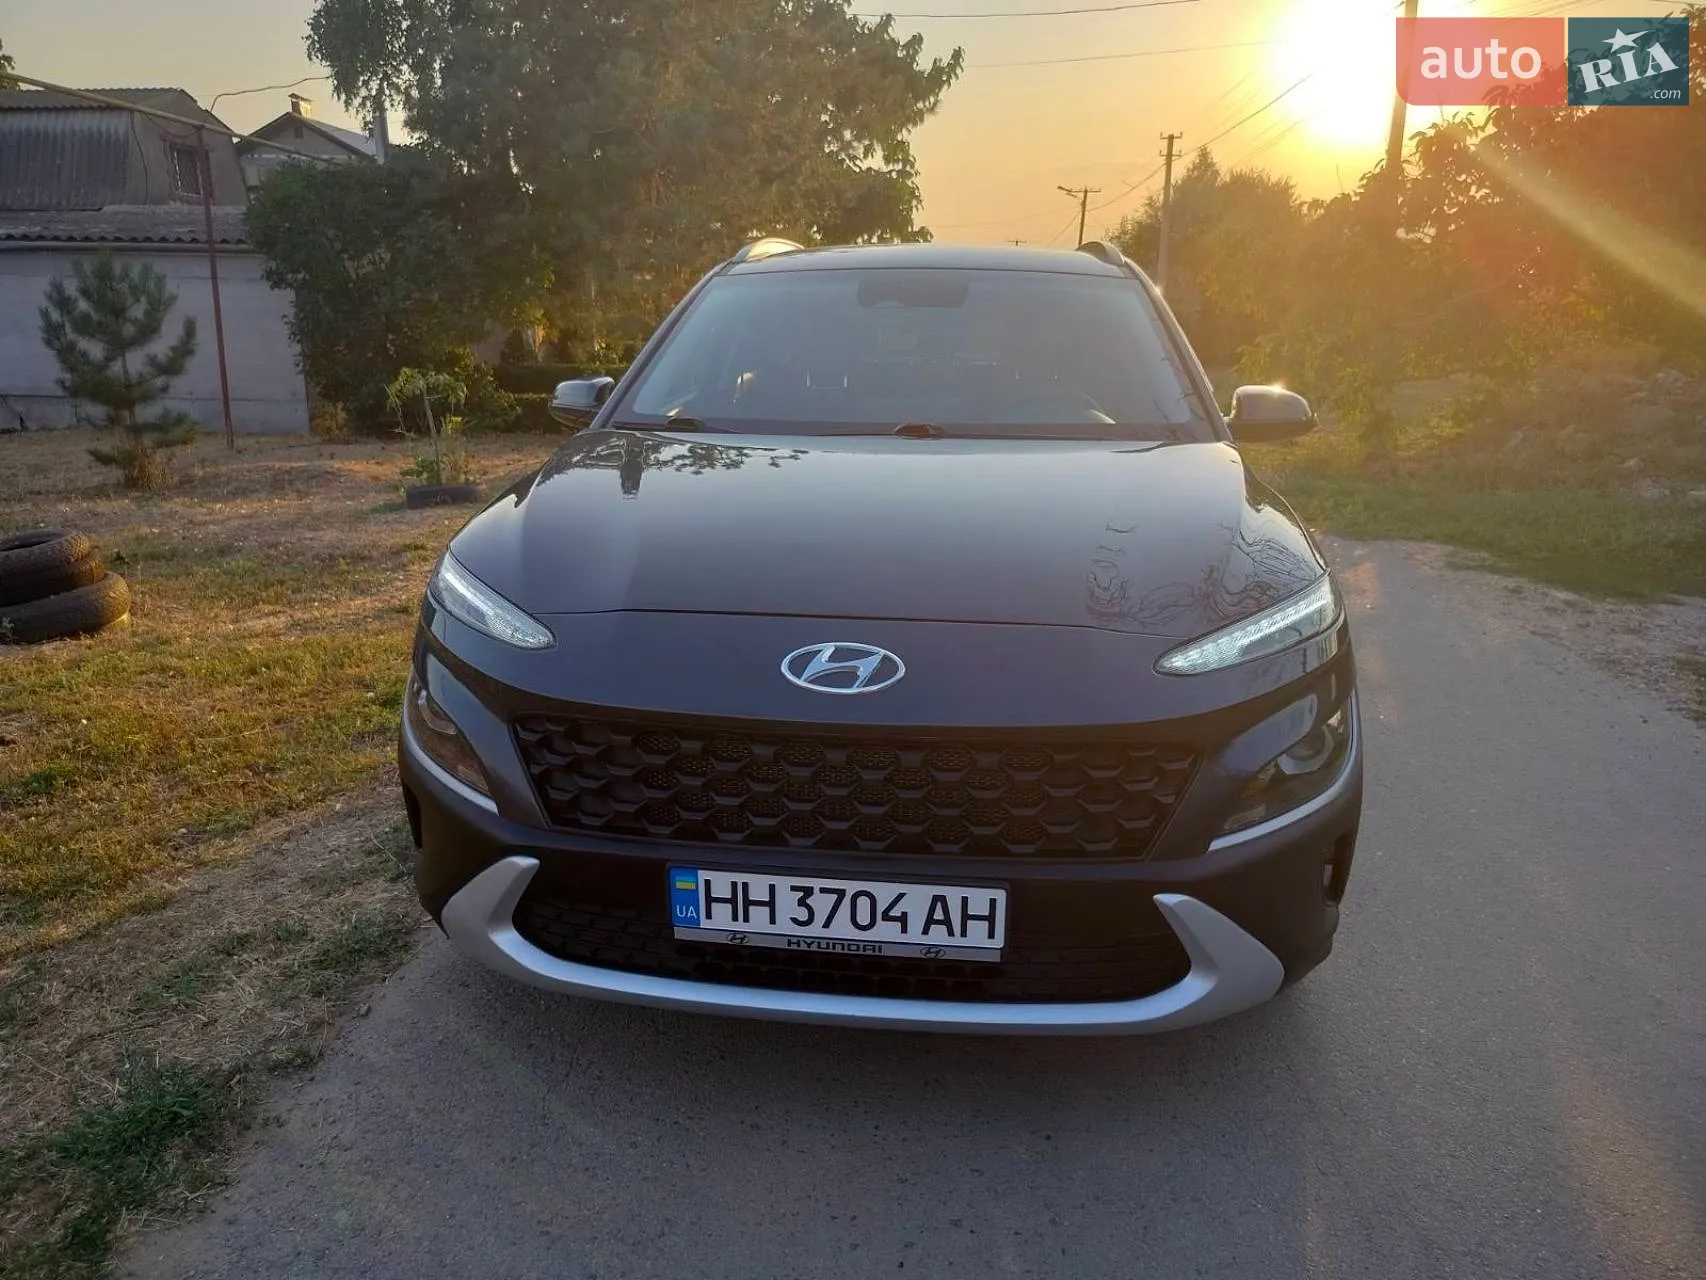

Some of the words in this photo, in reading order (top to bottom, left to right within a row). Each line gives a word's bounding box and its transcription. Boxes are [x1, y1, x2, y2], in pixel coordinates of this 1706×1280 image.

[676, 904, 697, 919] UA
[703, 878, 776, 925] HH
[789, 885, 908, 934] 3704
[921, 894, 997, 940] AH
[786, 938, 883, 955] HYUNDAI
